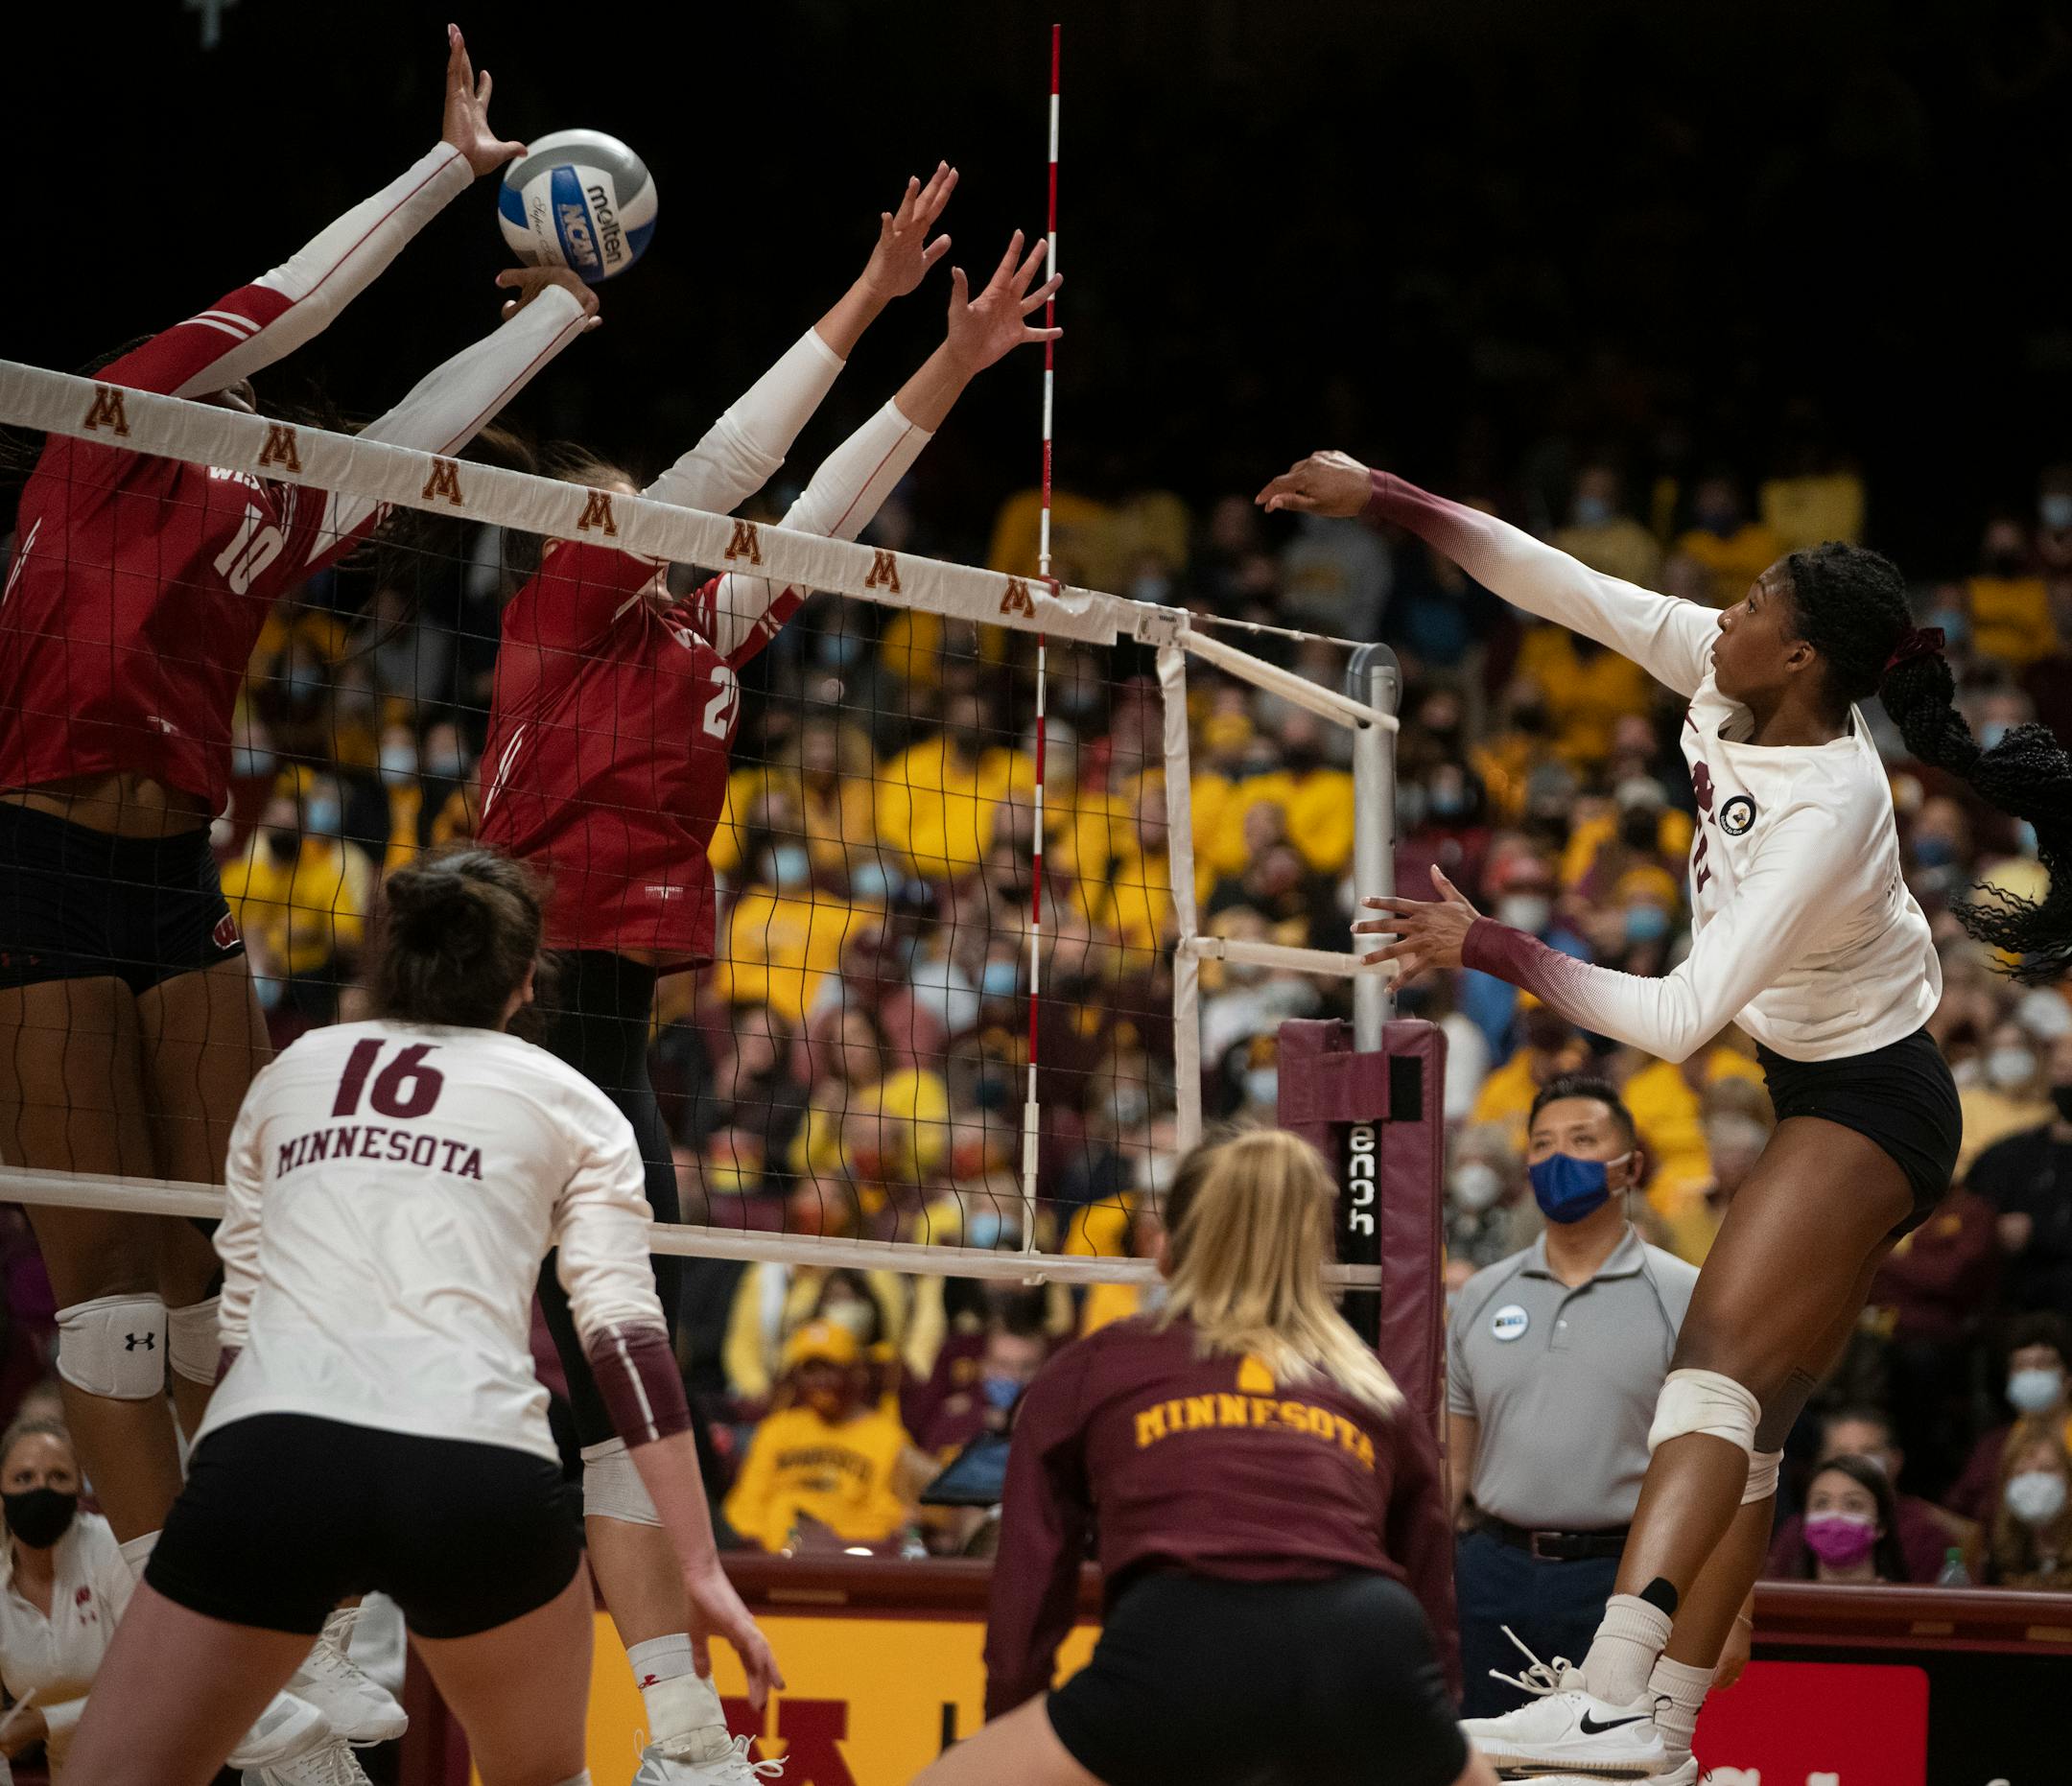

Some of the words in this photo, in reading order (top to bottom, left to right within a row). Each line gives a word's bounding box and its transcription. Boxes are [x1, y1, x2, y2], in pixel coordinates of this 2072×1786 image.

[586, 184, 623, 265] molten
[213, 502, 284, 596] 10
[703, 666, 740, 740] 2
[331, 1037, 445, 1119] 16
[275, 1125, 483, 1181] MINNESOTA
[1135, 1391, 1376, 1473] MINNESOTA
